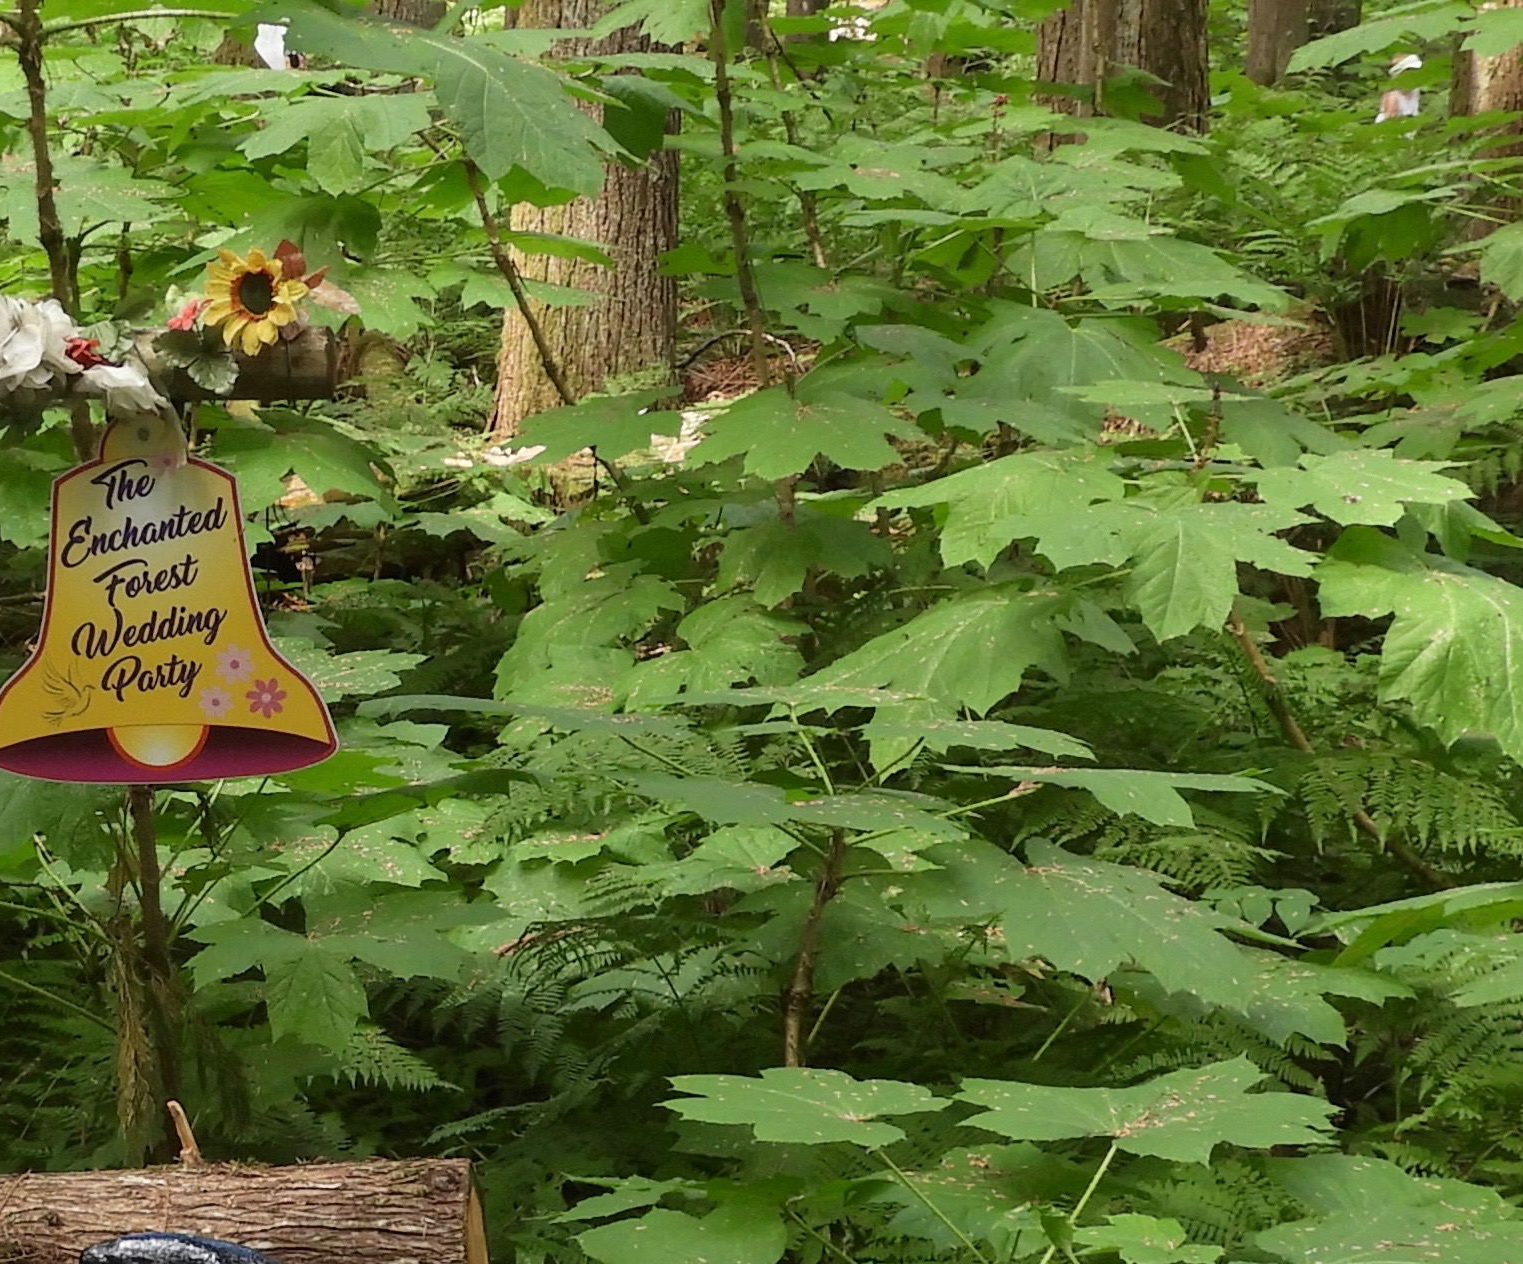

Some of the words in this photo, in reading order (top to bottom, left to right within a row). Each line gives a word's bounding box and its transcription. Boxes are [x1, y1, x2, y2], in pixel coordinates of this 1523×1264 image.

[91, 459, 156, 509] The
[61, 497, 228, 568] Enchanted
[93, 554, 199, 607] Forest
[71, 606, 228, 661] Wedding
[101, 654, 202, 702] Party
